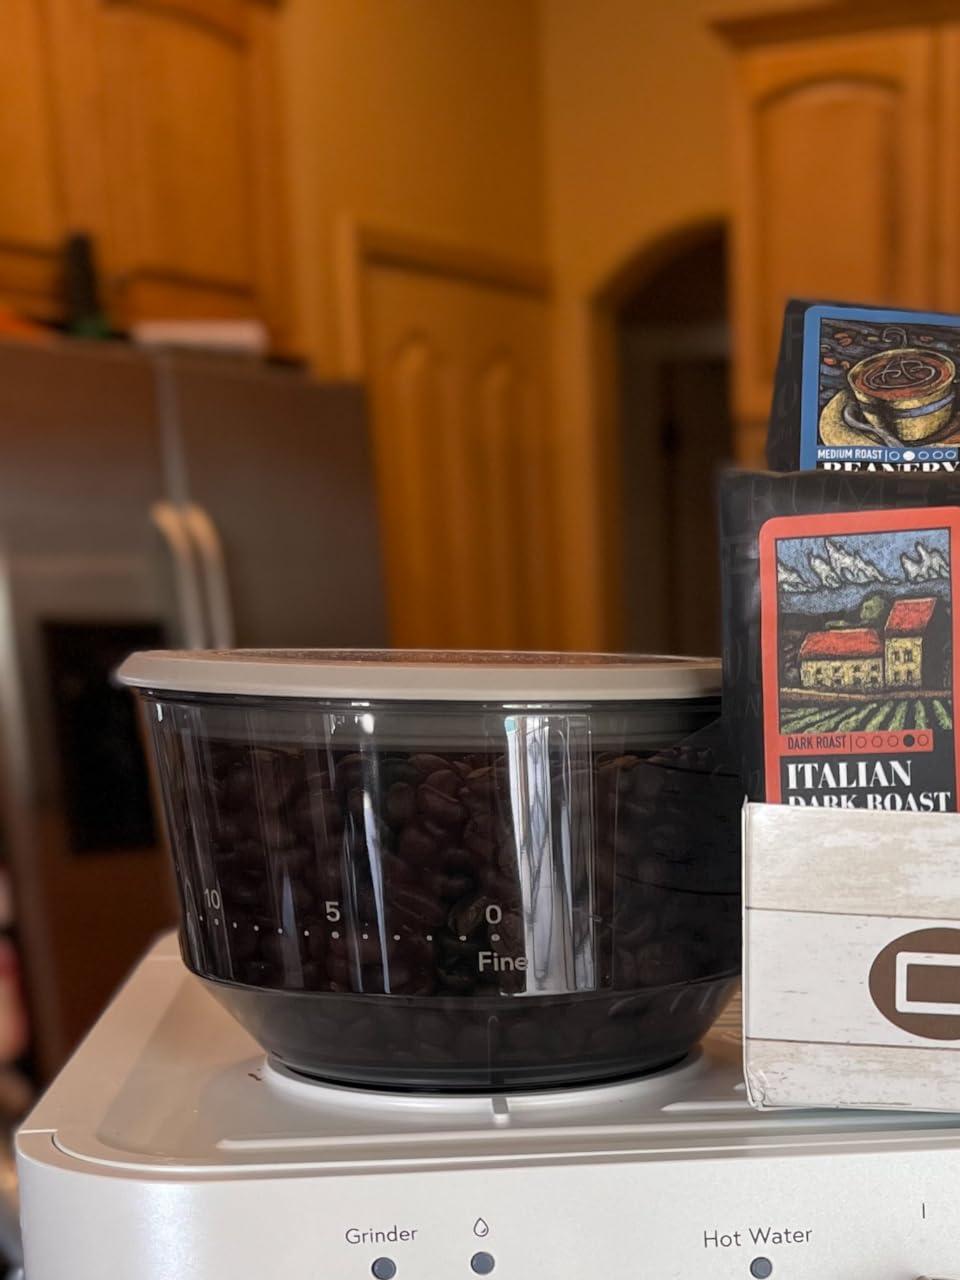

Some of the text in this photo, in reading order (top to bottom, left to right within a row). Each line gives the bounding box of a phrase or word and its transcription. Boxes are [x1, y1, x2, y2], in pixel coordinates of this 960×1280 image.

[817, 449, 882, 460] MEDIUM ROAST
[787, 735, 846, 750] DARK ROAST
[786, 760, 912, 789] ITALIAN
[866, 791, 951, 812] ROAST
[203, 888, 221, 910] 10
[325, 901, 341, 923] 5
[485, 905, 502, 924] 0
[478, 951, 529, 972] Fine
[345, 1225, 418, 1244] Grinder
[703, 1226, 813, 1248] Hot Water
